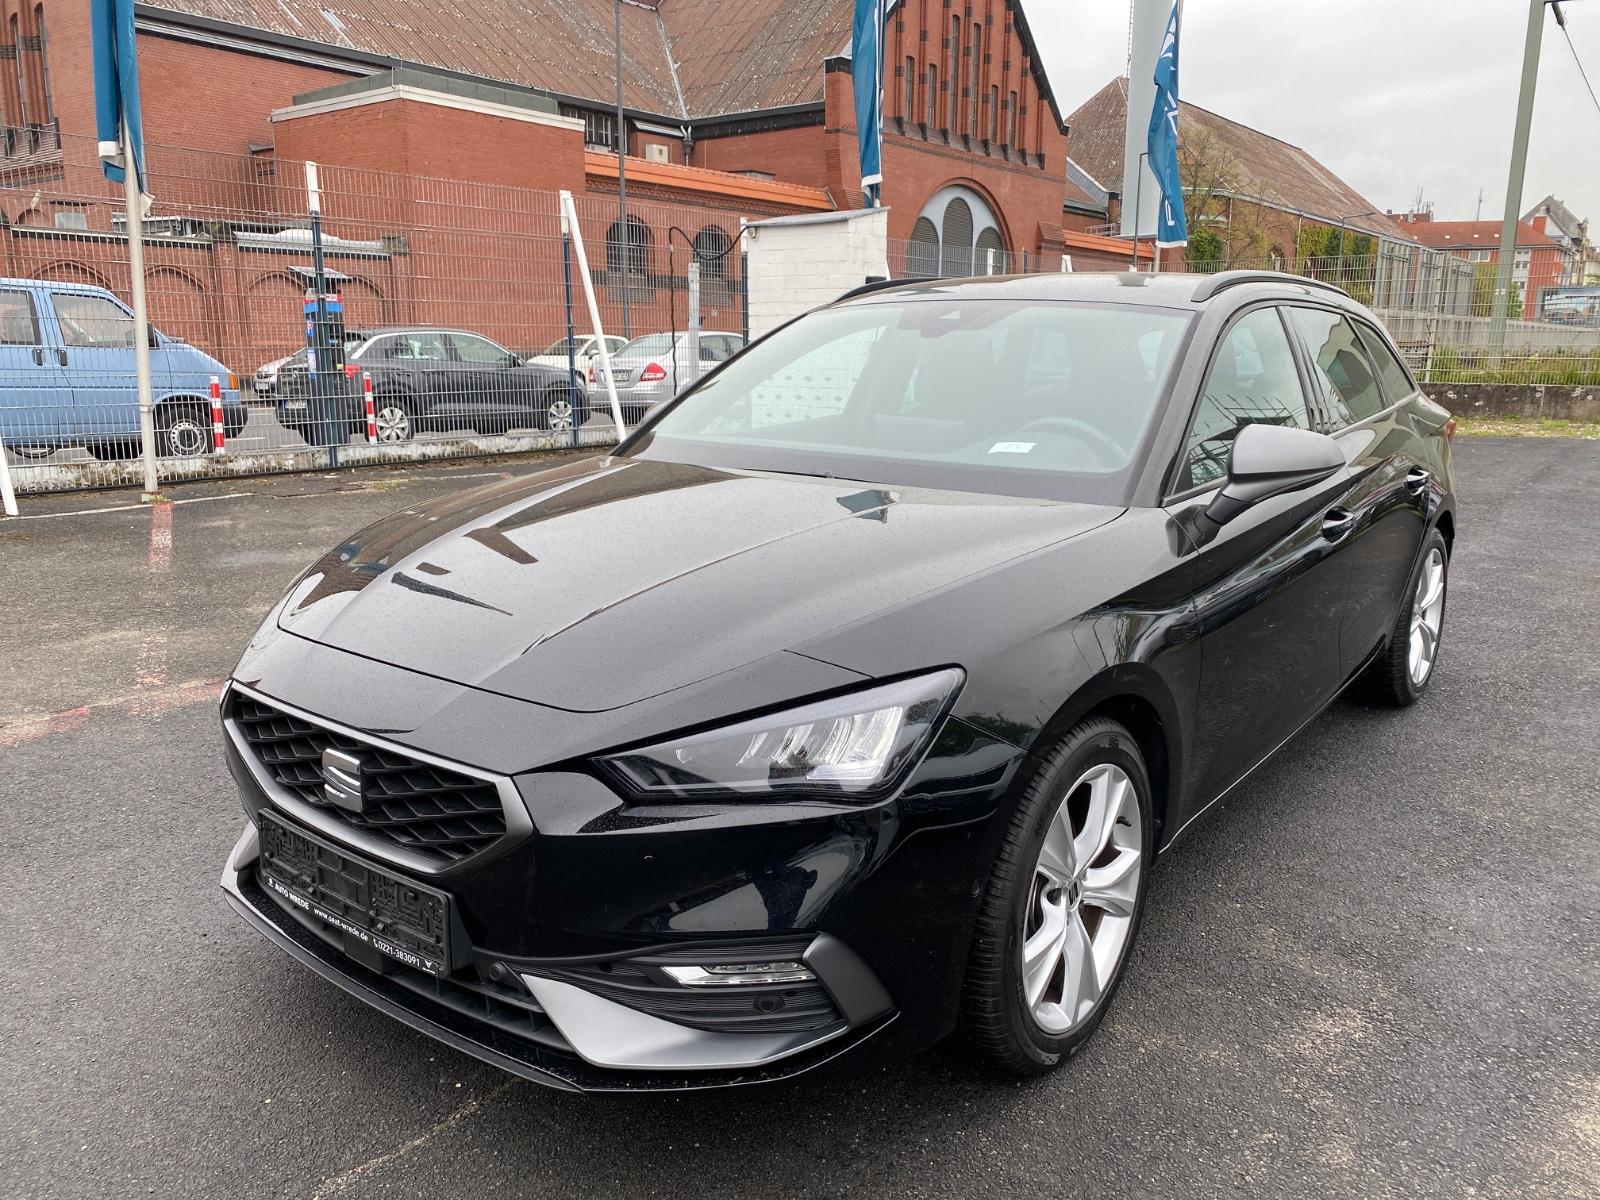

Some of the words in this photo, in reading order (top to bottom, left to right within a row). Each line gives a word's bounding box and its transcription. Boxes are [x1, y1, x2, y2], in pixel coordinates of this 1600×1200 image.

[275, 883, 289, 897] AUTO
[289, 892, 310, 910] WREDE
[313, 908, 369, 941] www.seat-wrede.de
[377, 941, 420, 967] 0221-383091
